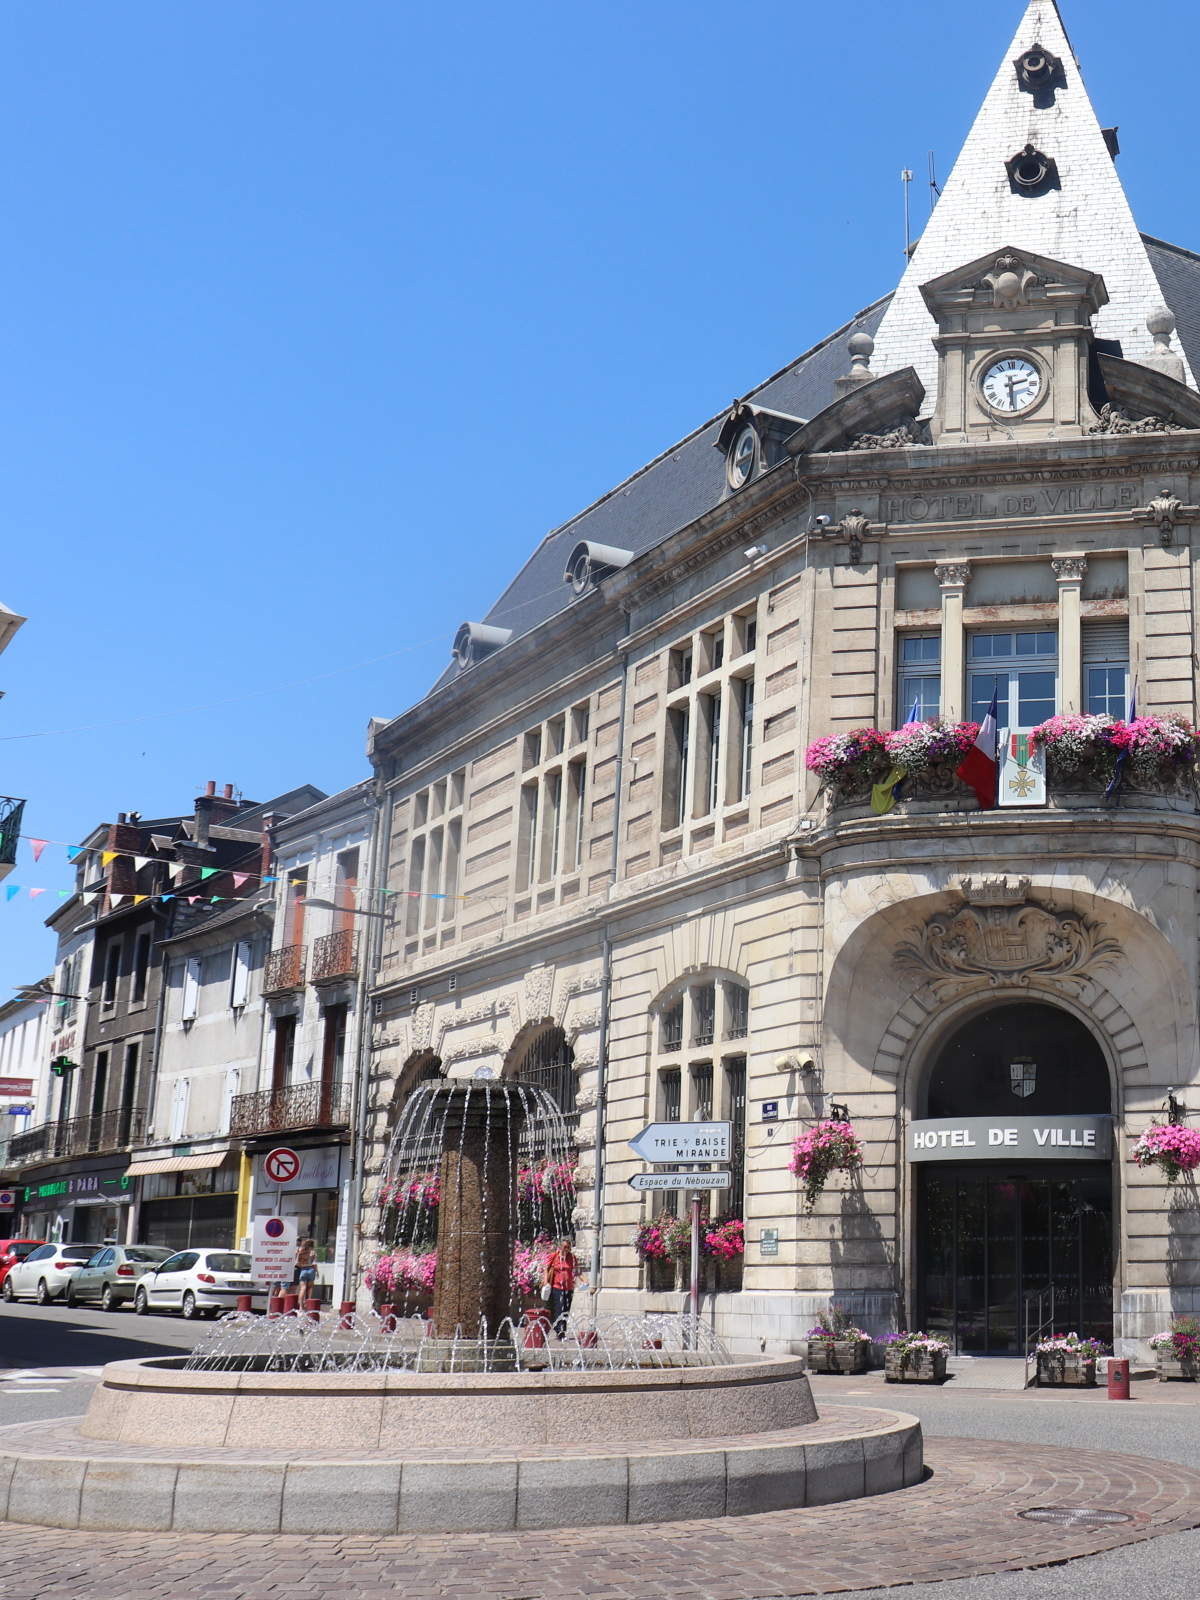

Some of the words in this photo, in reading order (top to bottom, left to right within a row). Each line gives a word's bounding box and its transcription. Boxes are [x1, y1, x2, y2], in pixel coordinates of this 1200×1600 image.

[886, 493, 997, 522] HÔTEL
[1003, 497, 1036, 515] DE
[1041, 485, 1139, 512] VILLE
[654, 1139, 678, 1147] TRIE
[695, 1138, 726, 1146] BAISE
[914, 1130, 976, 1149] HOTEL
[988, 1129, 1018, 1146] DE
[1033, 1129, 1096, 1146] VILLE
[676, 1149, 726, 1157] MIRANDE
[77, 1177, 98, 1191] PARA
[639, 1177, 669, 1187] Espace
[672, 1177, 682, 1186] du
[685, 1176, 726, 1185] Nébouzan
